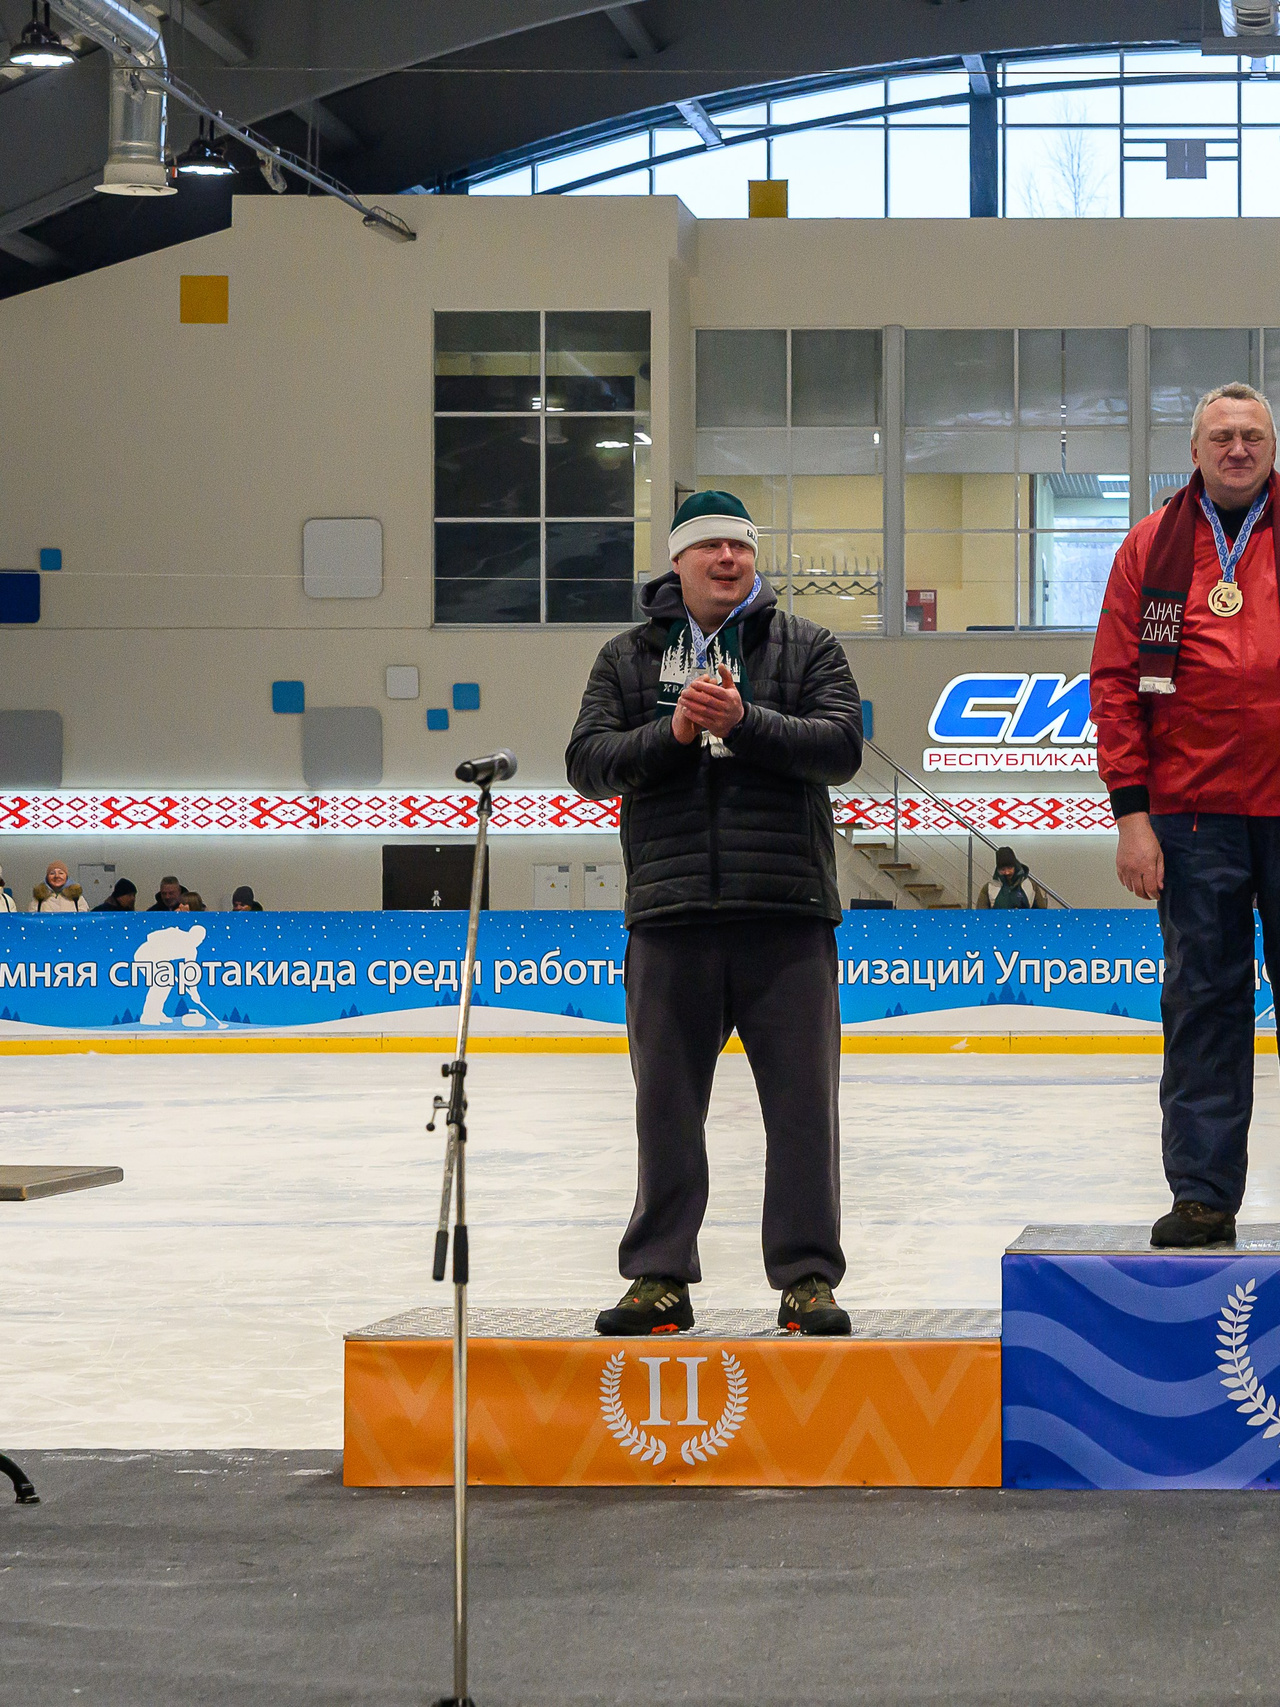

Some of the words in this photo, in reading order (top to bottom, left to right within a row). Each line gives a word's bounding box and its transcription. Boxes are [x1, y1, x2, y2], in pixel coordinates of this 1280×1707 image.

[928, 673, 1097, 744] СИ
[0, 961, 97, 988] мняя
[109, 960, 356, 994] спартакиада
[639, 1357, 708, 1425] II
